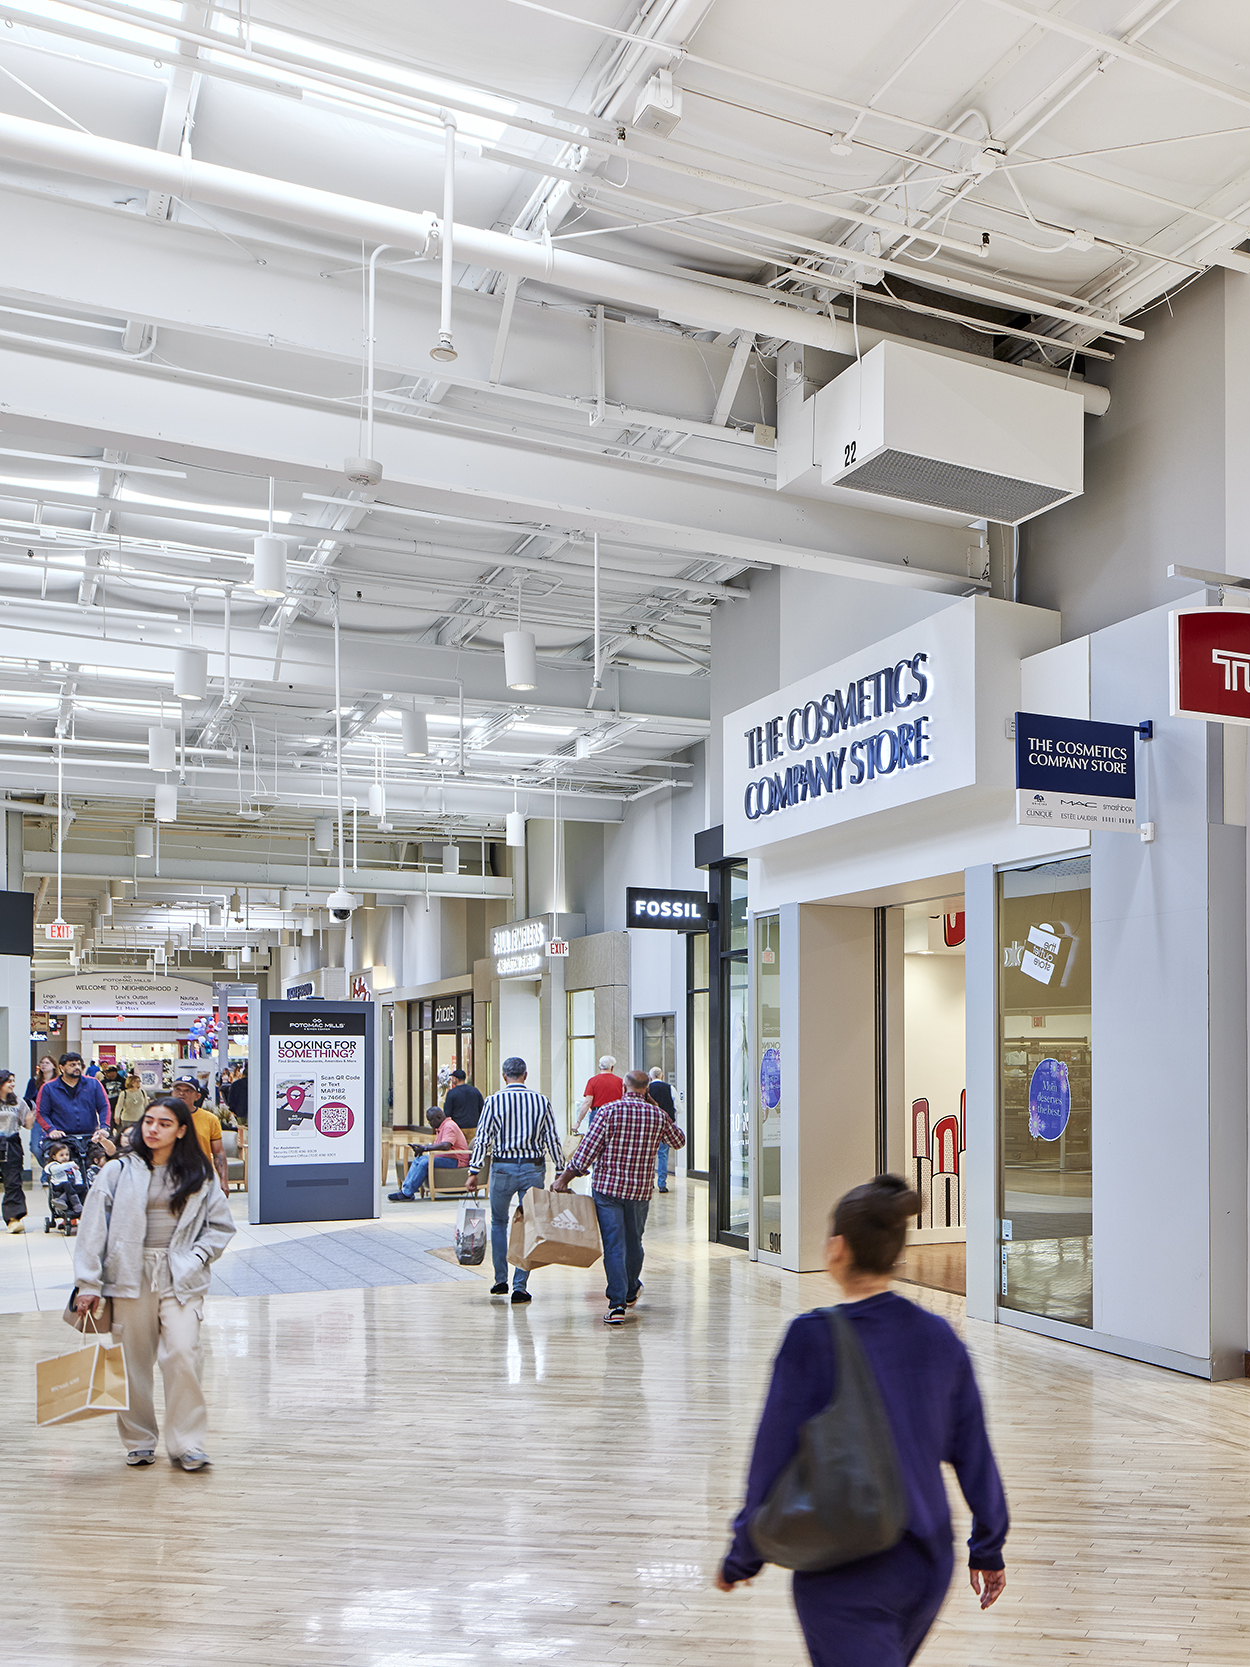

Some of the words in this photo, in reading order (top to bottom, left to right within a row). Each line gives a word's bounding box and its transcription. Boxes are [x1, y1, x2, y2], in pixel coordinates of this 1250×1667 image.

[844, 441, 857, 468] 22
[744, 715, 784, 769] THE
[786, 652, 929, 751] COSMETICS
[1028, 737, 1053, 752] THE
[1056, 741, 1127, 760] COSMETICS
[744, 746, 846, 820] COMPANY
[849, 716, 930, 785] STORE
[1028, 753, 1088, 770] COMPANY
[1091, 759, 1127, 774] STORE
[1060, 799, 1097, 808] MAC
[1102, 804, 1133, 812] smashbox
[1026, 810, 1053, 818] CLINIQUE
[1077, 814, 1098, 822] LAUDER
[635, 900, 701, 918] FOSSIL
[50, 925, 70, 938] EXIT
[511, 922, 544, 950] JEWELERS
[550, 942, 565, 954] EXIT
[278, 1041, 332, 1049] LOOKING
[334, 1041, 357, 1049] FOR
[278, 1049, 355, 1058] SOMETHING?
[1043, 1080, 1057, 1092] Mom
[1037, 1092, 1062, 1105] deserves
[1037, 1104, 1046, 1114] the
[551, 1220, 585, 1232] adidas
